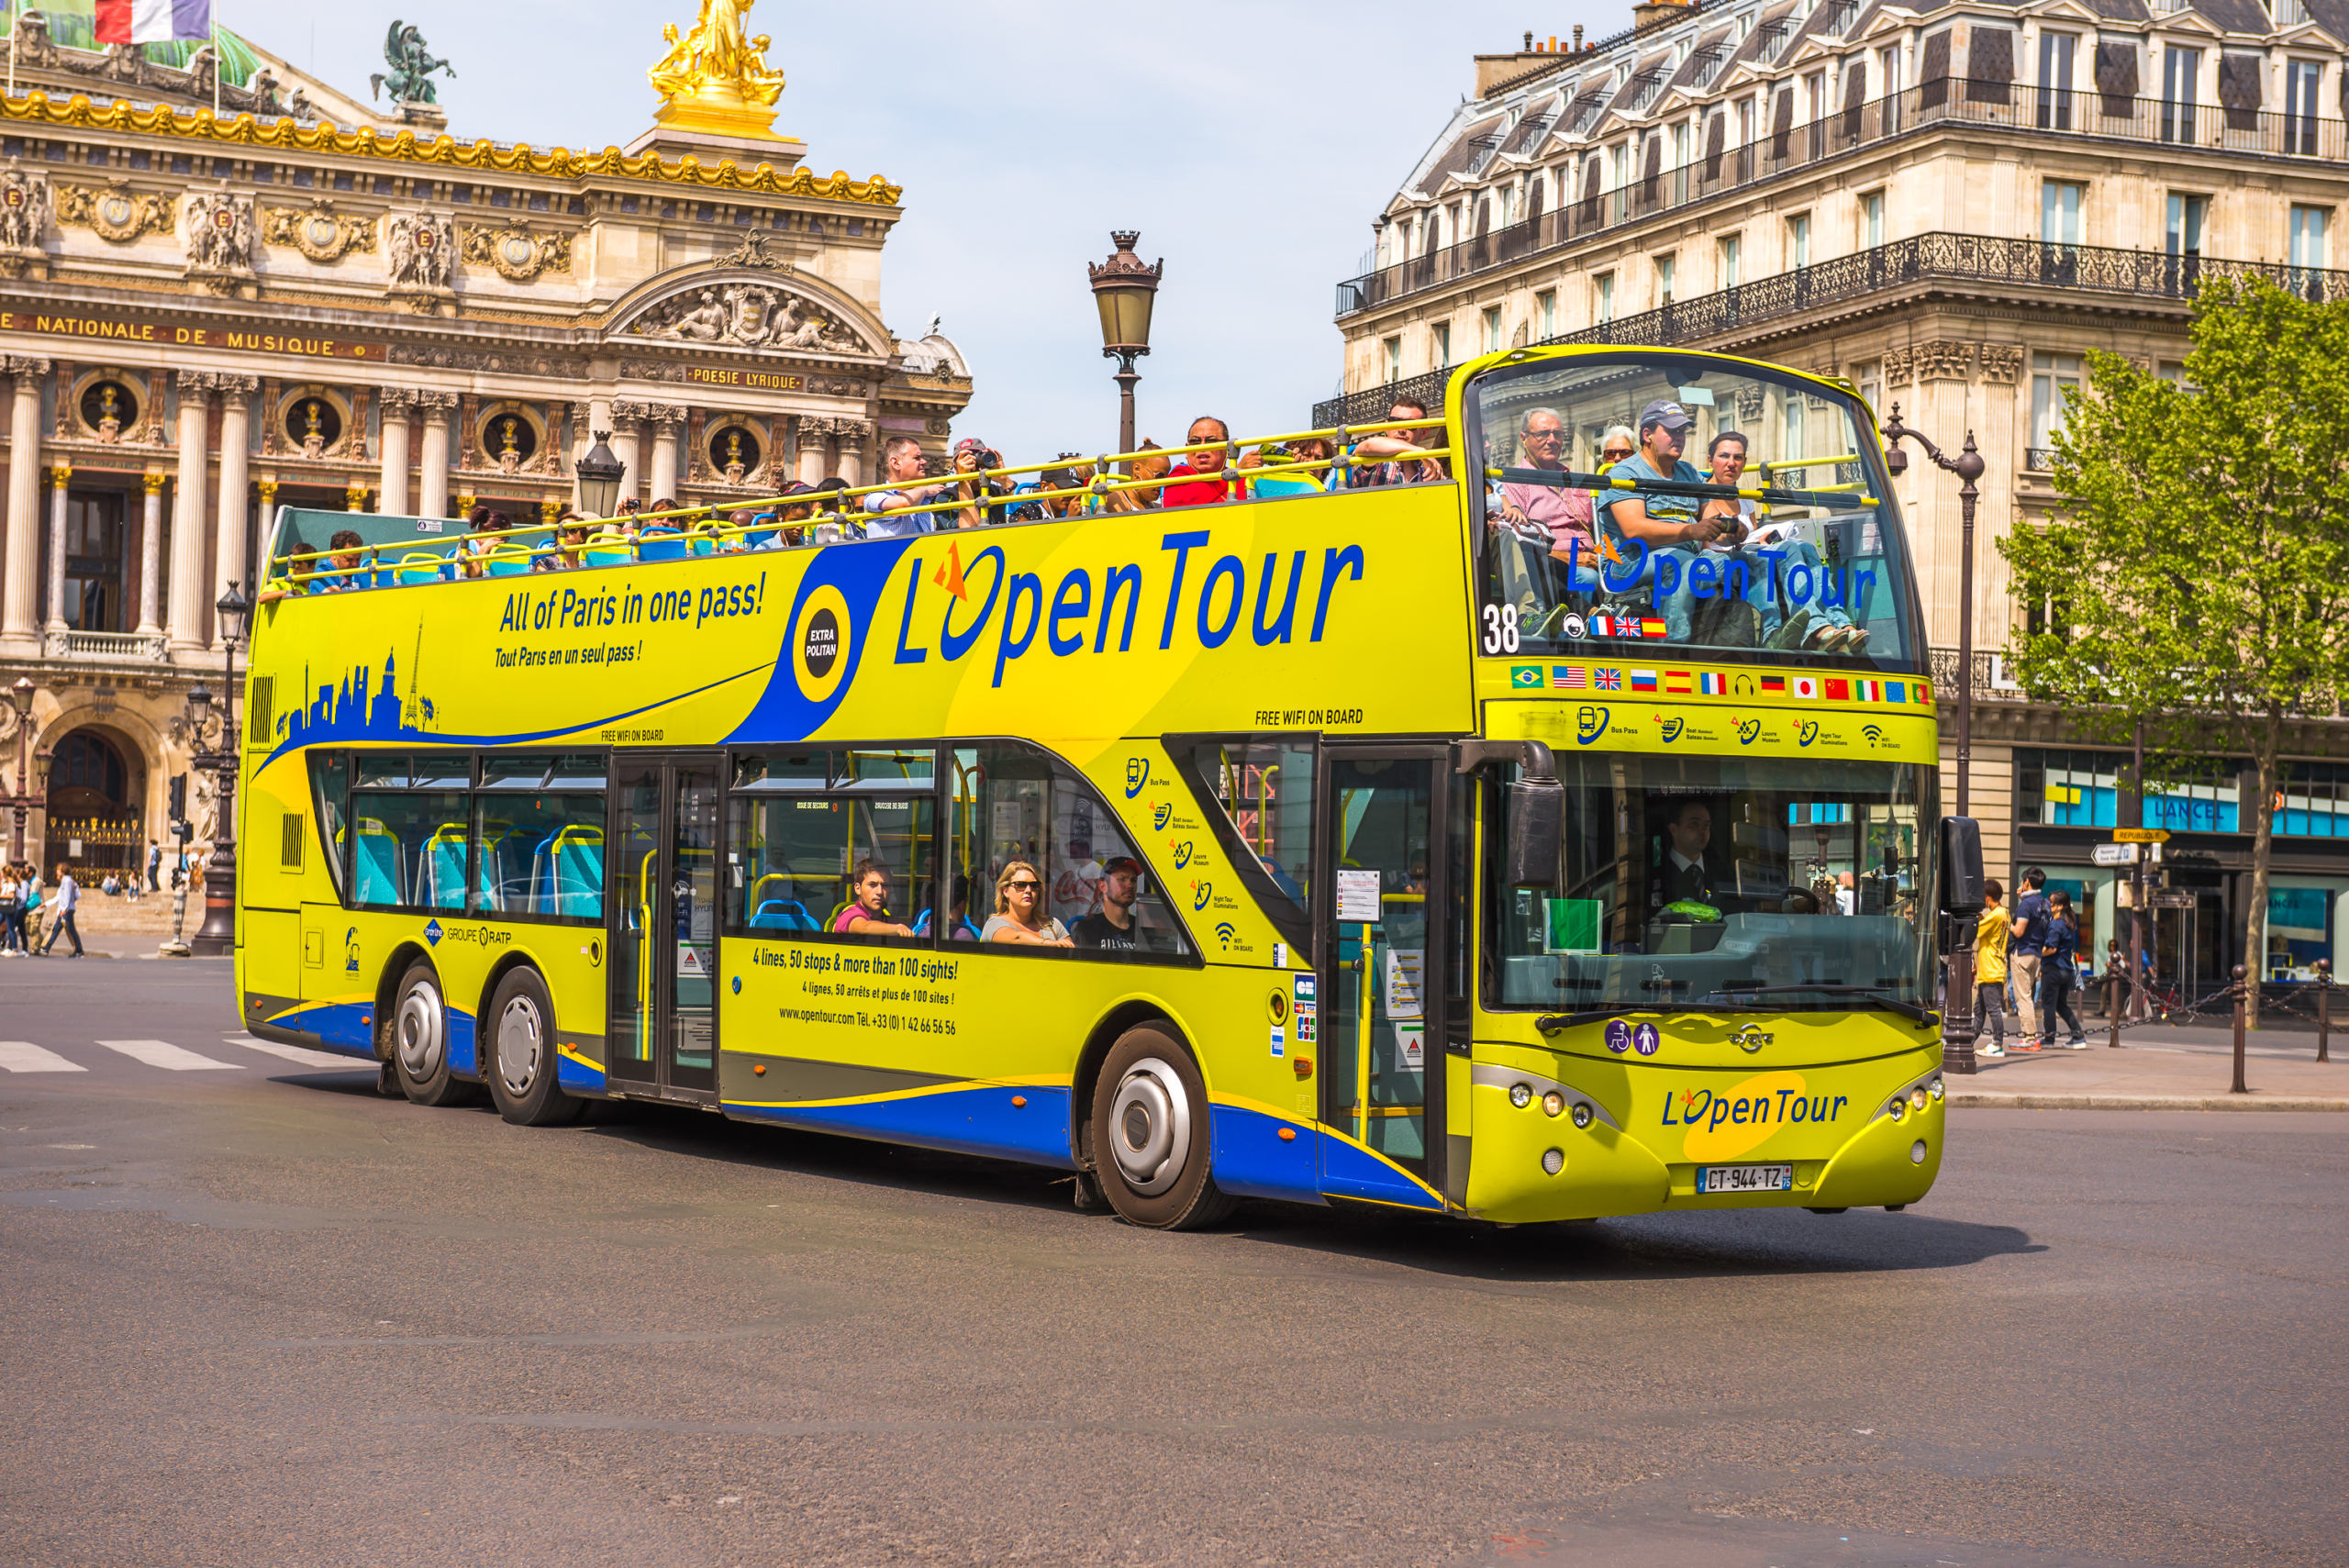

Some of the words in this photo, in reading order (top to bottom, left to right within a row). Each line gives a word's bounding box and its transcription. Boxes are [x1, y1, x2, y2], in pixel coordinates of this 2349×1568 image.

[37, 316, 154, 340] NATIONALE
[176, 328, 206, 345] DE
[228, 332, 334, 356] MUSIQUE
[694, 369, 739, 384] POESIE
[746, 373, 796, 389] LYRIQUE
[499, 592, 529, 632] All
[534, 590, 557, 630] of
[560, 585, 617, 628] Paris
[622, 584, 643, 624] in
[650, 589, 691, 622] one
[696, 571, 766, 629] pass!
[810, 628, 834, 641] EXTRA
[1483, 603, 1518, 654] 38
[495, 647, 517, 668] Tout
[518, 646, 546, 666] Paris
[549, 651, 562, 665] en
[564, 650, 578, 664] un
[581, 642, 606, 663] seul
[607, 645, 634, 667] pass
[806, 644, 836, 657] POLITAN
[1255, 710, 1280, 725] FREE
[1283, 710, 1306, 725] WIFI
[1308, 710, 1323, 724] ON
[1326, 709, 1364, 724] BOARD
[601, 730, 616, 741] FREE
[617, 730, 630, 741] WIFI
[632, 729, 640, 741] ON
[642, 729, 663, 741] BOARD
[2154, 801, 2224, 819] LANCEL
[2174, 849, 2217, 859] ANCEL
[2268, 899, 2299, 908] ANCEL
[448, 929, 477, 942] GROUPE
[489, 931, 511, 944] RATP
[753, 948, 760, 965] 4
[762, 948, 786, 969] lines,
[790, 950, 802, 968] 50
[804, 952, 830, 974] stops
[833, 952, 841, 972] &
[843, 957, 870, 974] more
[873, 956, 895, 976] than
[899, 957, 918, 977] 100
[920, 961, 959, 984] sights!
[802, 981, 807, 993] 4
[808, 982, 833, 998] lignes,
[835, 984, 845, 995] 50
[847, 984, 870, 998] arrêts
[872, 988, 880, 999] et
[882, 988, 898, 1002] plus
[901, 989, 910, 1001] de
[913, 990, 927, 1003] 100
[929, 991, 949, 1005] sites
[779, 1007, 854, 1026] www.opentour.com
[856, 1011, 871, 1028] Tél.
[872, 1015, 887, 1029] +33
[889, 1015, 899, 1031] (0)
[901, 1016, 906, 1030] 1
[908, 1018, 918, 1032] 42
[920, 1018, 930, 1033] 66
[932, 1019, 943, 1034] 56
[945, 1020, 956, 1035] 56
[1297, 1024, 1315, 1033] JCB
[1783, 1177, 1791, 1187] 75
